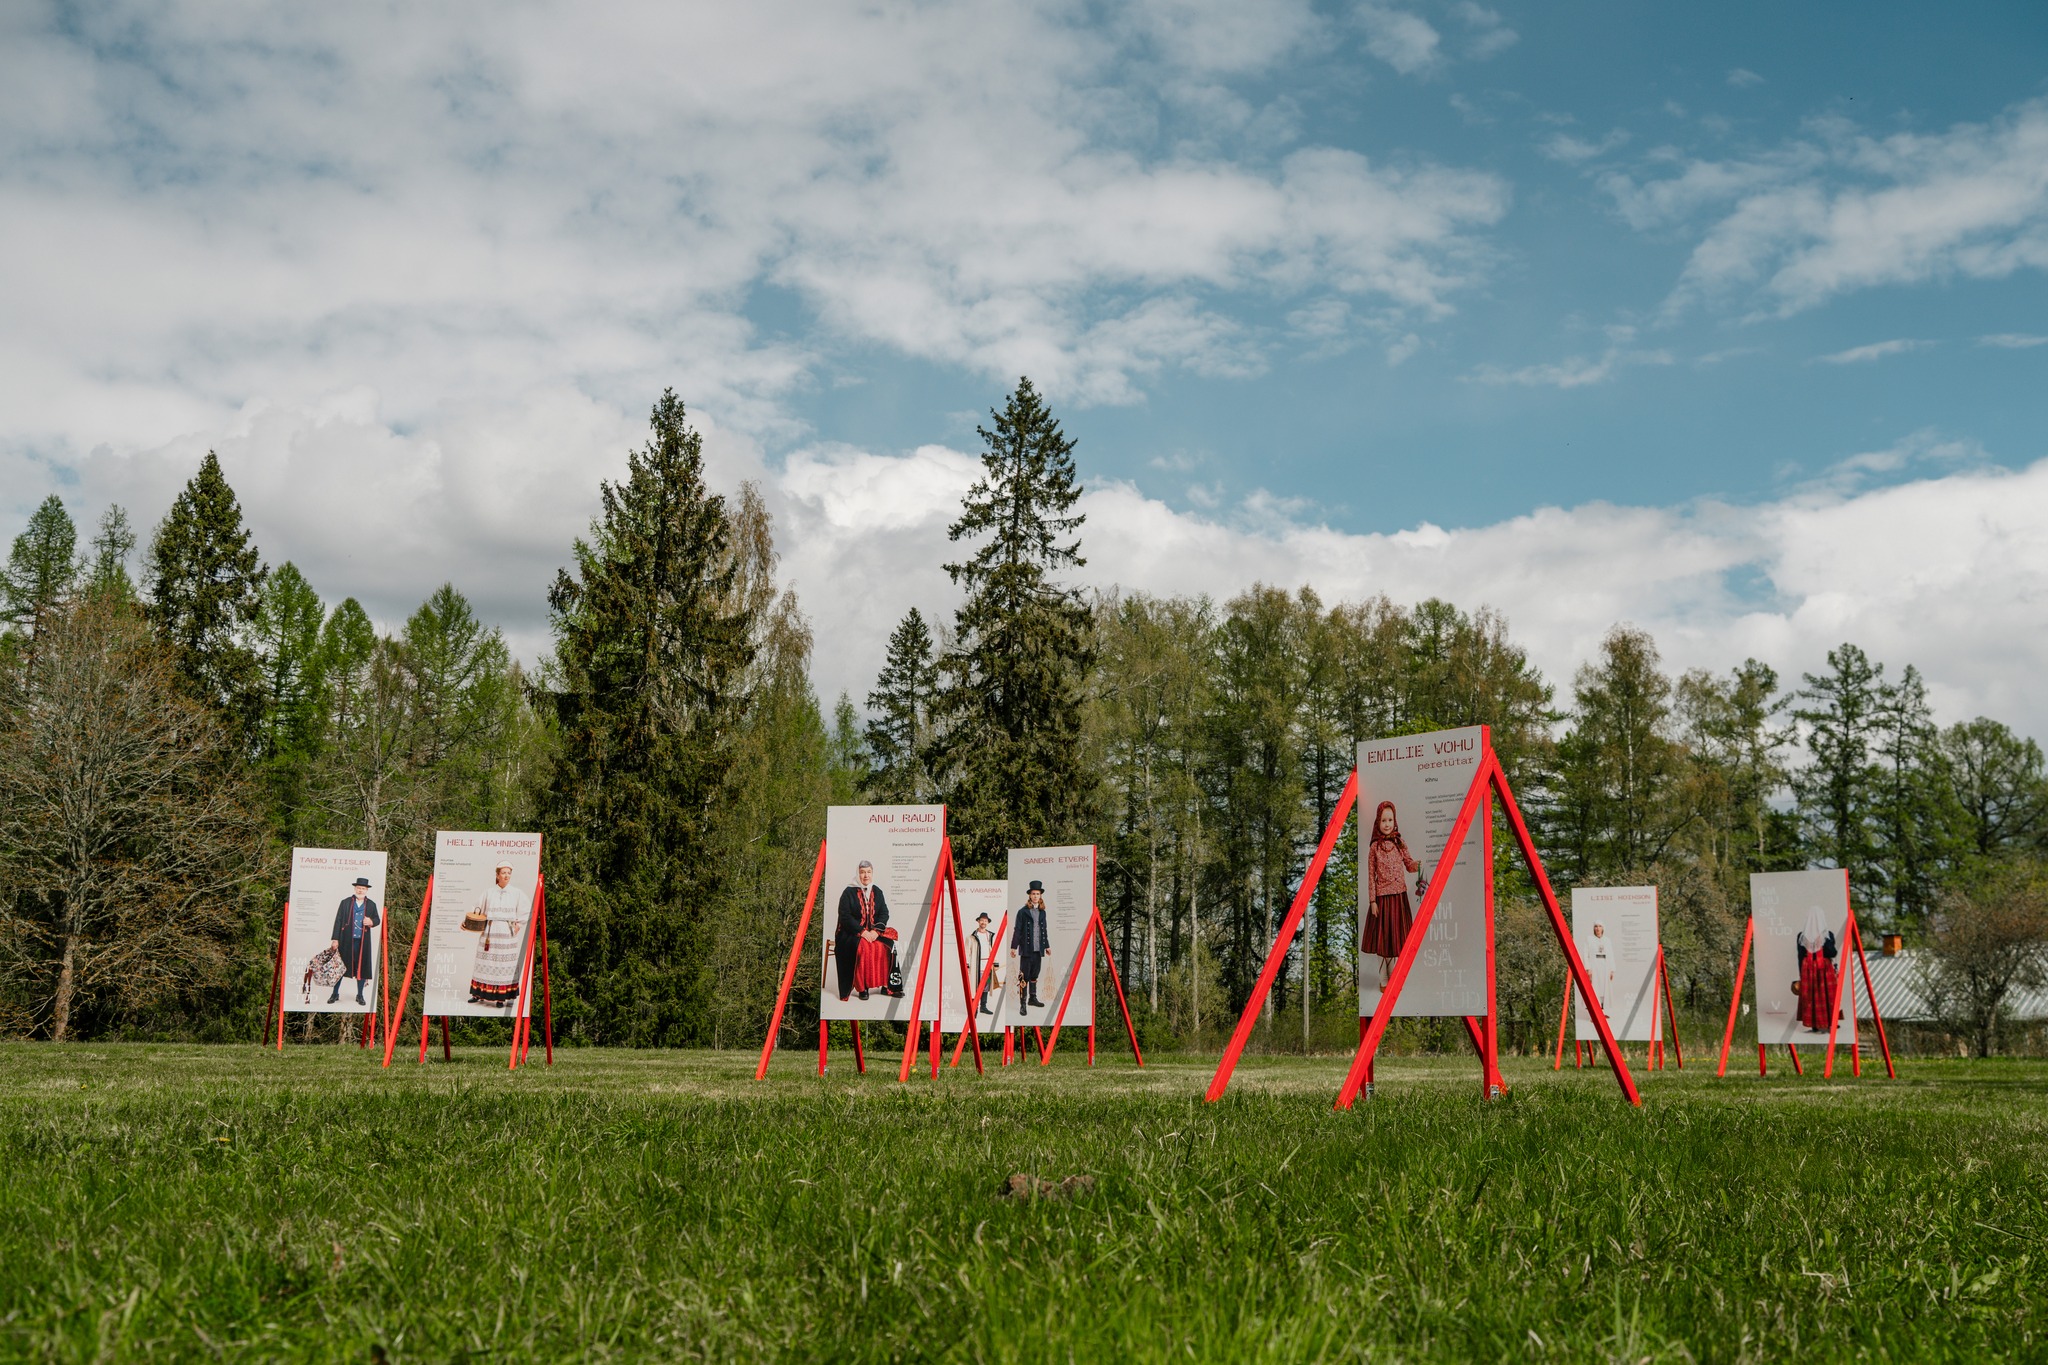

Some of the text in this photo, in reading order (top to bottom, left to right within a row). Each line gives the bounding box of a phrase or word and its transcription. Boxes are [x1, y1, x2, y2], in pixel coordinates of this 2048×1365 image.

[1367, 744, 1424, 764] EMILIE
[1417, 756, 1474, 772] peretütar
[869, 813, 936, 823] ANU RAUD
[446, 838, 537, 848] HELI HAHNDORF
[333, 858, 371, 866] TIISLER
[1023, 855, 1089, 865] SANDER ETVERK
[1429, 922, 1458, 941] MU
